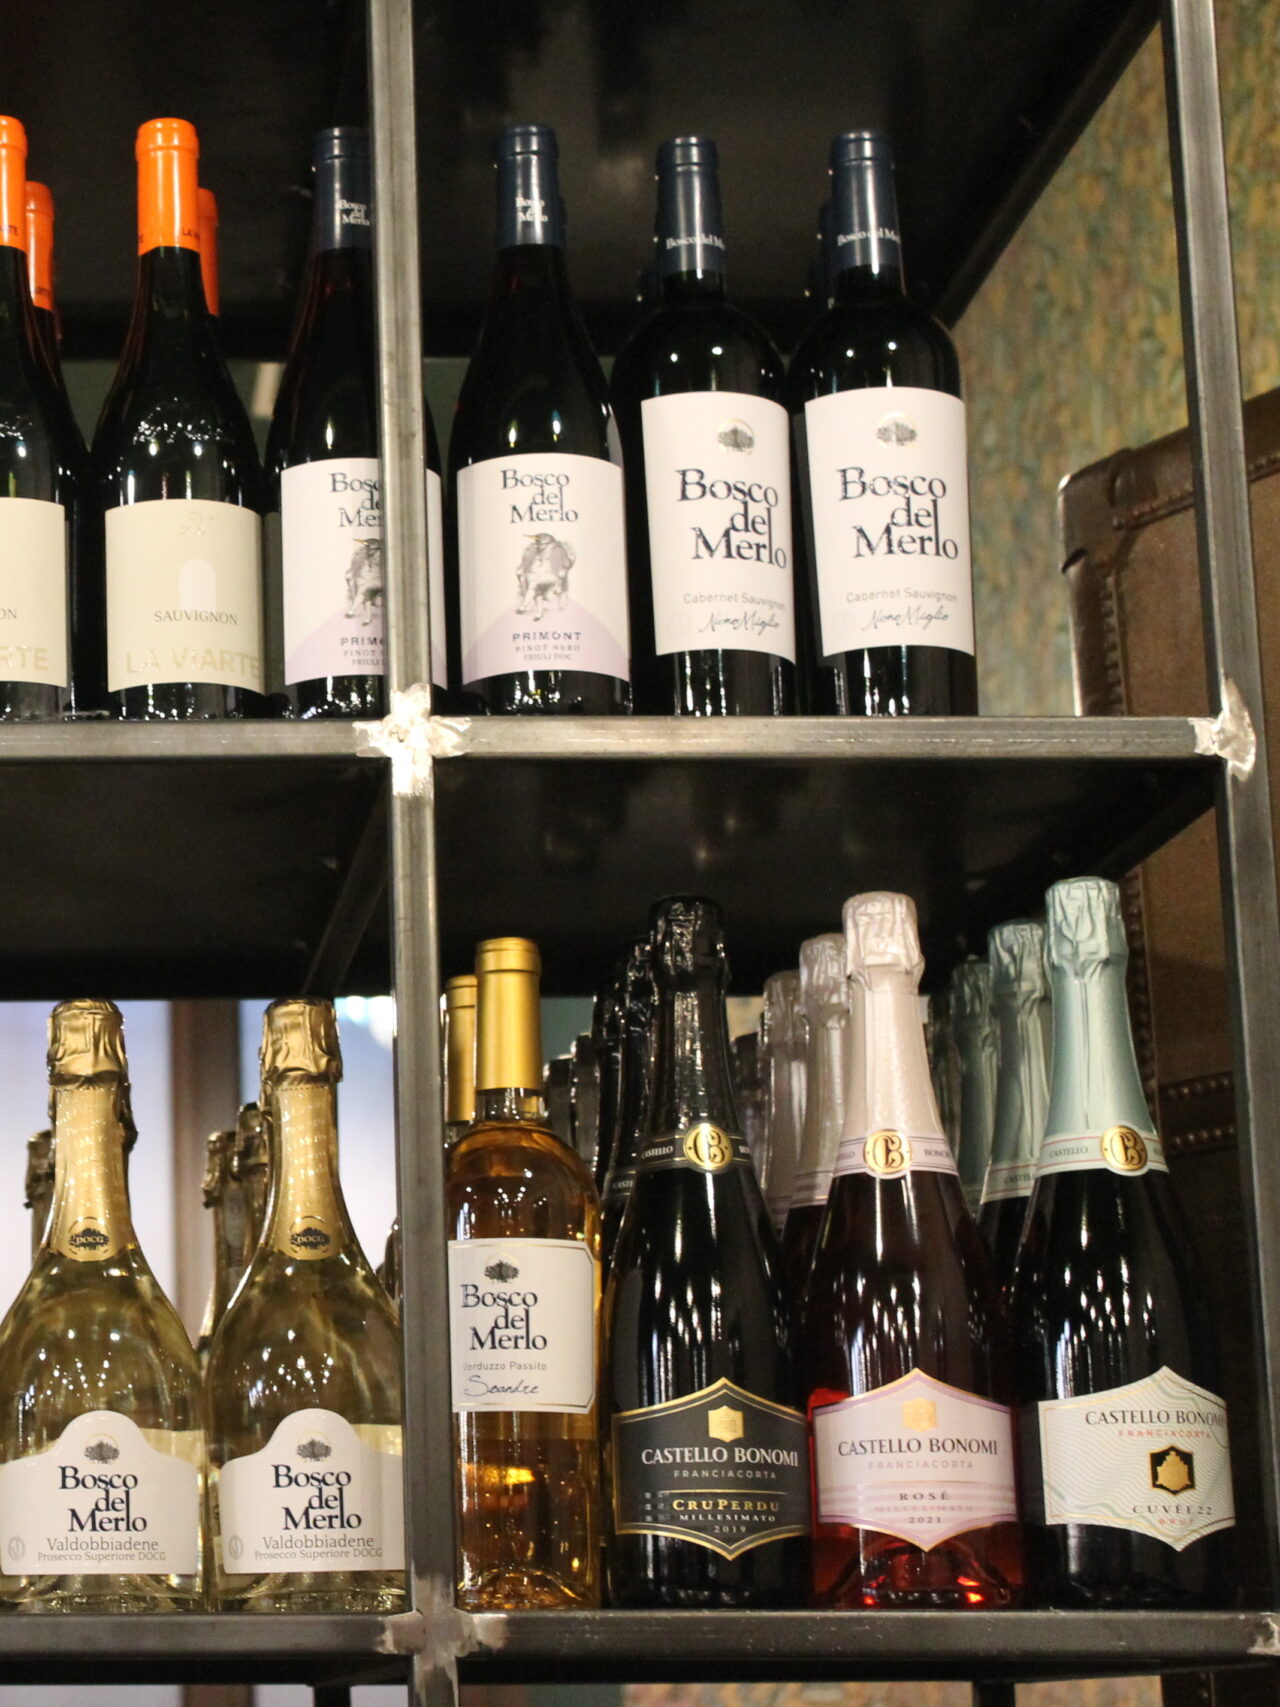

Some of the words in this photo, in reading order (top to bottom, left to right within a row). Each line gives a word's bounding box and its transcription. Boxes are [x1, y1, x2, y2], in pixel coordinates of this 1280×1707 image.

[330, 472, 381, 494] Bosc
[501, 469, 570, 490] Bosco
[676, 468, 778, 507] Bosco
[836, 467, 947, 501] Bosco
[361, 491, 381, 510] de
[532, 486, 564, 506] del
[338, 507, 384, 528] Mer
[510, 503, 579, 524] Merlo
[730, 500, 772, 536] del
[891, 494, 938, 528] del
[692, 527, 787, 569] Merlo
[852, 522, 959, 560] Merlo
[683, 592, 738, 604] Cabernet
[740, 593, 786, 611] Sauvignon
[846, 590, 902, 602] Cabernet
[905, 588, 958, 604] Sauvignon
[154, 610, 238, 626] SAUVIGNON
[126, 650, 161, 675] LA
[172, 648, 261, 679] VIARTE
[1049, 1146, 1089, 1159] CASTELLO
[77, 1235, 104, 1244] DOCG
[461, 1284, 538, 1308] Bosco
[494, 1304, 530, 1330] del
[469, 1326, 548, 1351] Merlo
[509, 1361, 548, 1372] Passito
[1085, 1410, 1170, 1426] CASTELLO
[1119, 1429, 1213, 1439] FRANCIACORTA
[641, 1446, 728, 1465] CASTELLO
[734, 1446, 799, 1467] BONOMI
[838, 1438, 922, 1457] CASTELLO
[929, 1437, 999, 1456] BONOMI
[673, 1469, 777, 1480] FRANCIACORTA
[869, 1460, 974, 1470] FRANCIACORTA
[58, 1466, 138, 1490] Bosco
[271, 1464, 352, 1488] Bosco
[94, 1486, 131, 1512] del
[308, 1485, 344, 1510] del
[899, 1490, 950, 1501] ROSÉ
[68, 1508, 147, 1533] Merlo
[283, 1506, 362, 1531] Merlo
[679, 1513, 776, 1523] MILLESIMATO
[909, 1515, 942, 1525] 2021
[1197, 1506, 1213, 1516] 22
[714, 1525, 747, 1534] 2019
[47, 1536, 160, 1551] Valdobbiadene
[262, 1533, 375, 1549] Valdobbiadene
[37, 1552, 81, 1561] Prosecco
[84, 1552, 136, 1563] Superiore
[138, 1551, 167, 1561] DOCG
[255, 1550, 297, 1560] Prosecco
[300, 1549, 351, 1561] Superiore
[353, 1547, 384, 1558] DOCG
